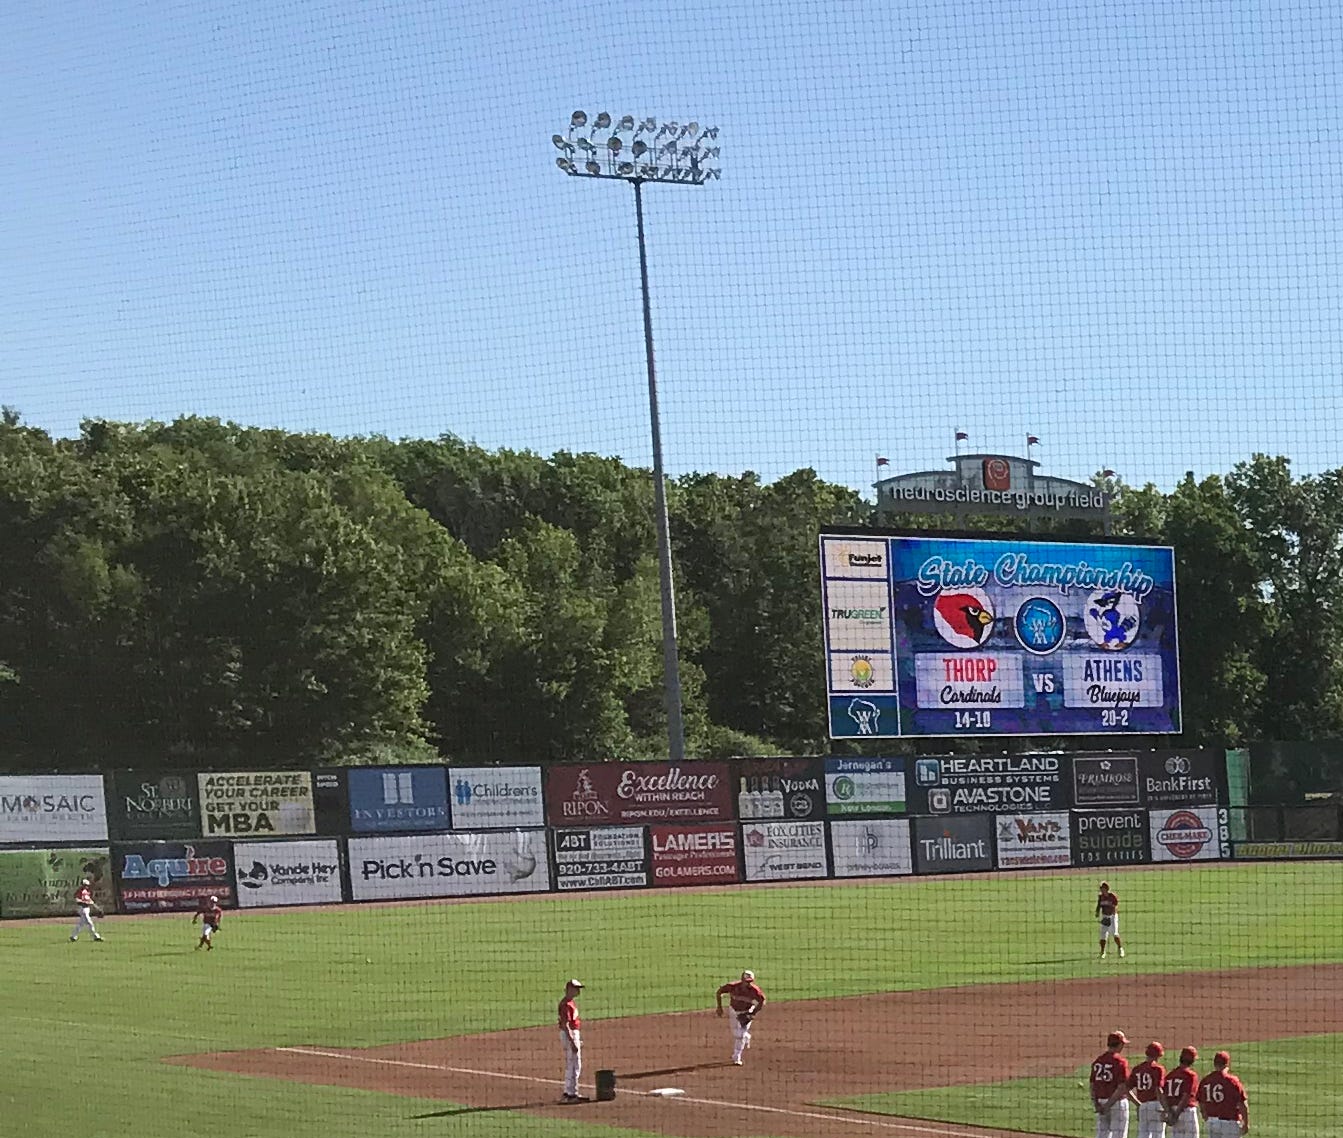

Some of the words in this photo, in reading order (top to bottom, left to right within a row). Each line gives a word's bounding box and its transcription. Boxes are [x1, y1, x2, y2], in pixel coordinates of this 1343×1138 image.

[893, 486, 1011, 504] neuroscience
[1016, 491, 1065, 510] group
[1068, 491, 1104, 508] field
[849, 554, 882, 562] Funjet
[918, 555, 988, 596] State
[994, 553, 1153, 604] Championship
[832, 609, 885, 619] TRUGREEN
[943, 658, 997, 682] THORP
[1084, 659, 1143, 683] ATHENS
[1032, 673, 1055, 693] VS
[940, 685, 1001, 705] Cardinals
[1087, 684, 1141, 706] Bluejays
[941, 758, 1059, 773] HEARTLAND
[206, 774, 301, 786] ACCELERATE
[617, 768, 720, 798] Excellence
[781, 779, 819, 793] VODKA
[941, 775, 1001, 785] BUSINESS
[1006, 774, 1059, 783] SYSTEMS
[1146, 776, 1211, 792] BankFirst
[205, 788, 245, 798] YOUR
[249, 787, 309, 798] CAREER
[473, 783, 537, 797] Children's
[635, 792, 670, 801] WITHIN
[672, 791, 705, 800] REACH
[953, 787, 1050, 804] AVASTONE
[205, 802, 235, 812] GET
[240, 801, 280, 811] YOUR
[354, 806, 445, 819] INVESTORS
[563, 801, 609, 816] RIPON
[954, 803, 1033, 813] TECHNOLOGIES
[207, 813, 274, 833] MBA
[767, 825, 786, 838] FOX
[788, 823, 822, 837] CITIES
[1078, 813, 1142, 834] prevent
[561, 835, 586, 848] ABT
[653, 832, 735, 851] LAMERS
[768, 837, 822, 849] INSURANCE
[1078, 832, 1143, 849] suicide
[920, 838, 985, 861] Trilliant
[269, 863, 308, 876] Vande
[312, 862, 336, 875] Hey
[362, 859, 412, 880] Pick
[437, 857, 496, 877] Save
[560, 861, 643, 874] 920-733-4ABT
[655, 865, 735, 878] GOLAMERS.COM
[1093, 1063, 1113, 1082] 25
[1135, 1072, 1152, 1091] 19
[1166, 1078, 1183, 1097] 17
[1204, 1083, 1224, 1103] 16
